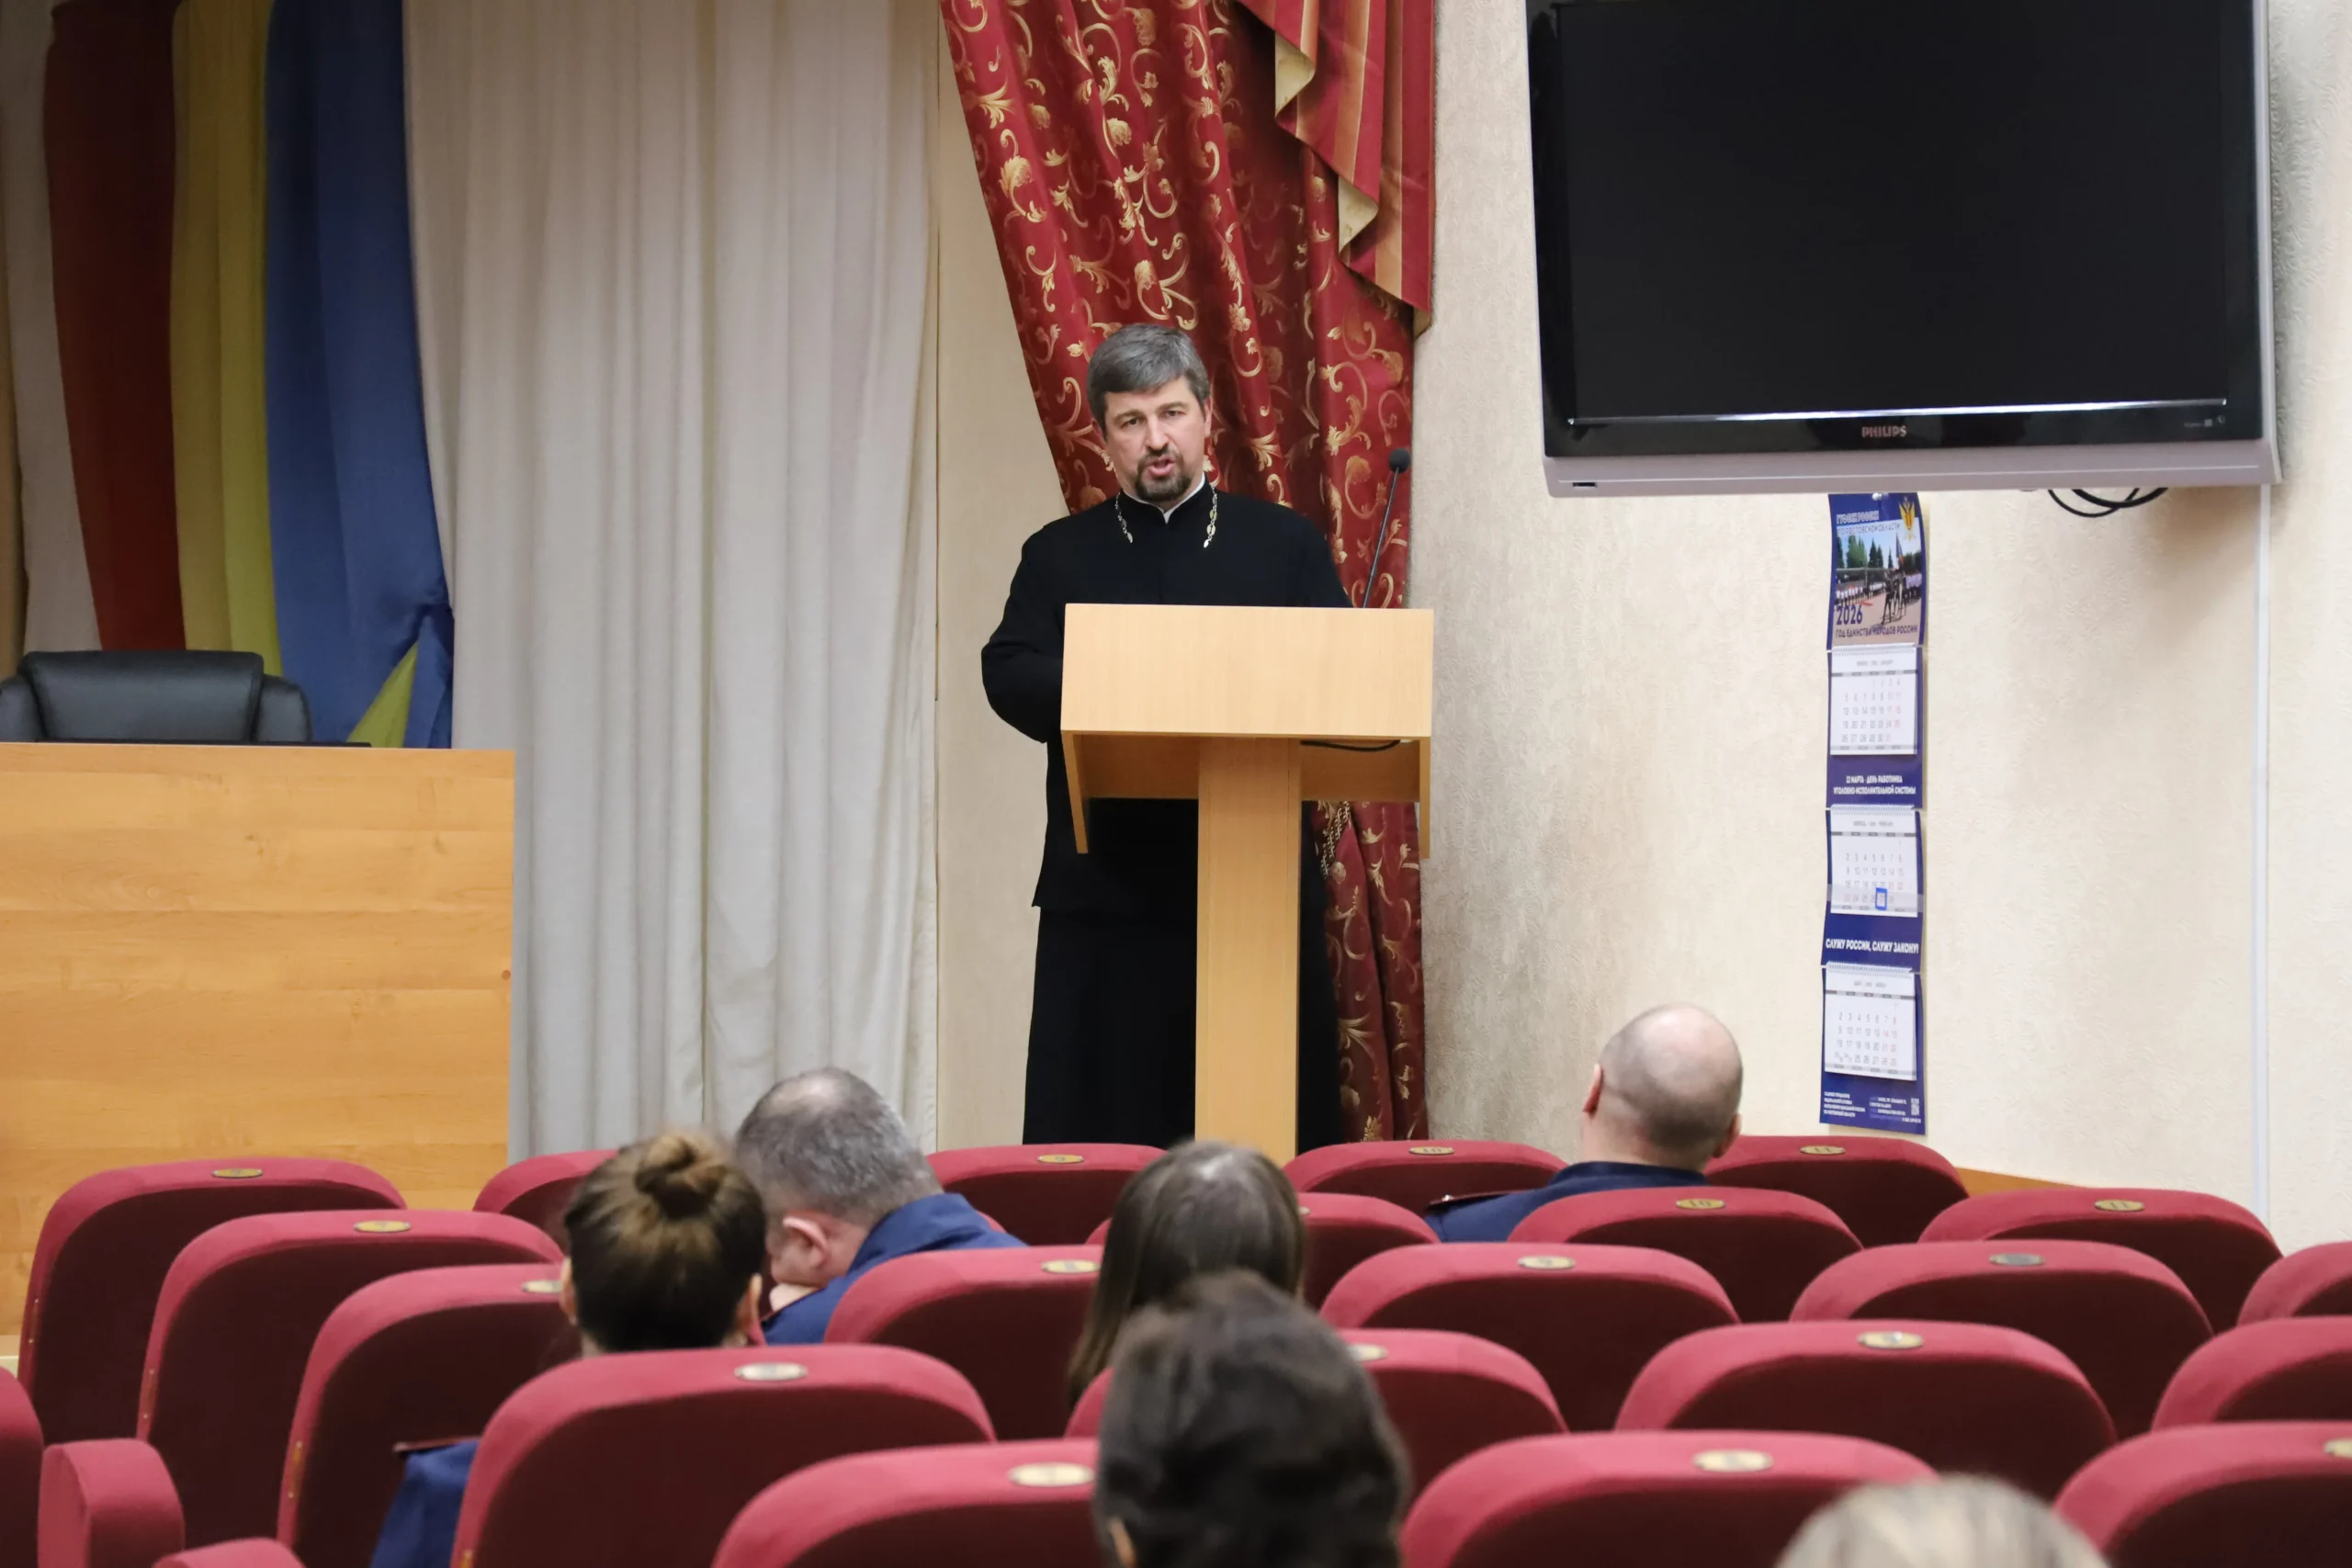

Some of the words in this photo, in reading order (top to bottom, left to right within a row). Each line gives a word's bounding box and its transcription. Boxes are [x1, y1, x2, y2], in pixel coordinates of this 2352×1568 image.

[1861, 425, 1907, 437] PHILIPS
[1836, 604, 1863, 626] 2026
[1836, 628, 1846, 637] ГОД
[1847, 627, 1871, 637] ЕДИНСТВА
[1897, 625, 1918, 634] РОССИИ
[1866, 775, 1878, 784] ДЕНЬ
[1826, 938, 1846, 950] СЛУЖУ
[1846, 939, 1871, 952] РОССИИ,
[1871, 941, 1894, 953] СЛУЖУ
[1894, 942, 1919, 954] ЗАКОНУ!
